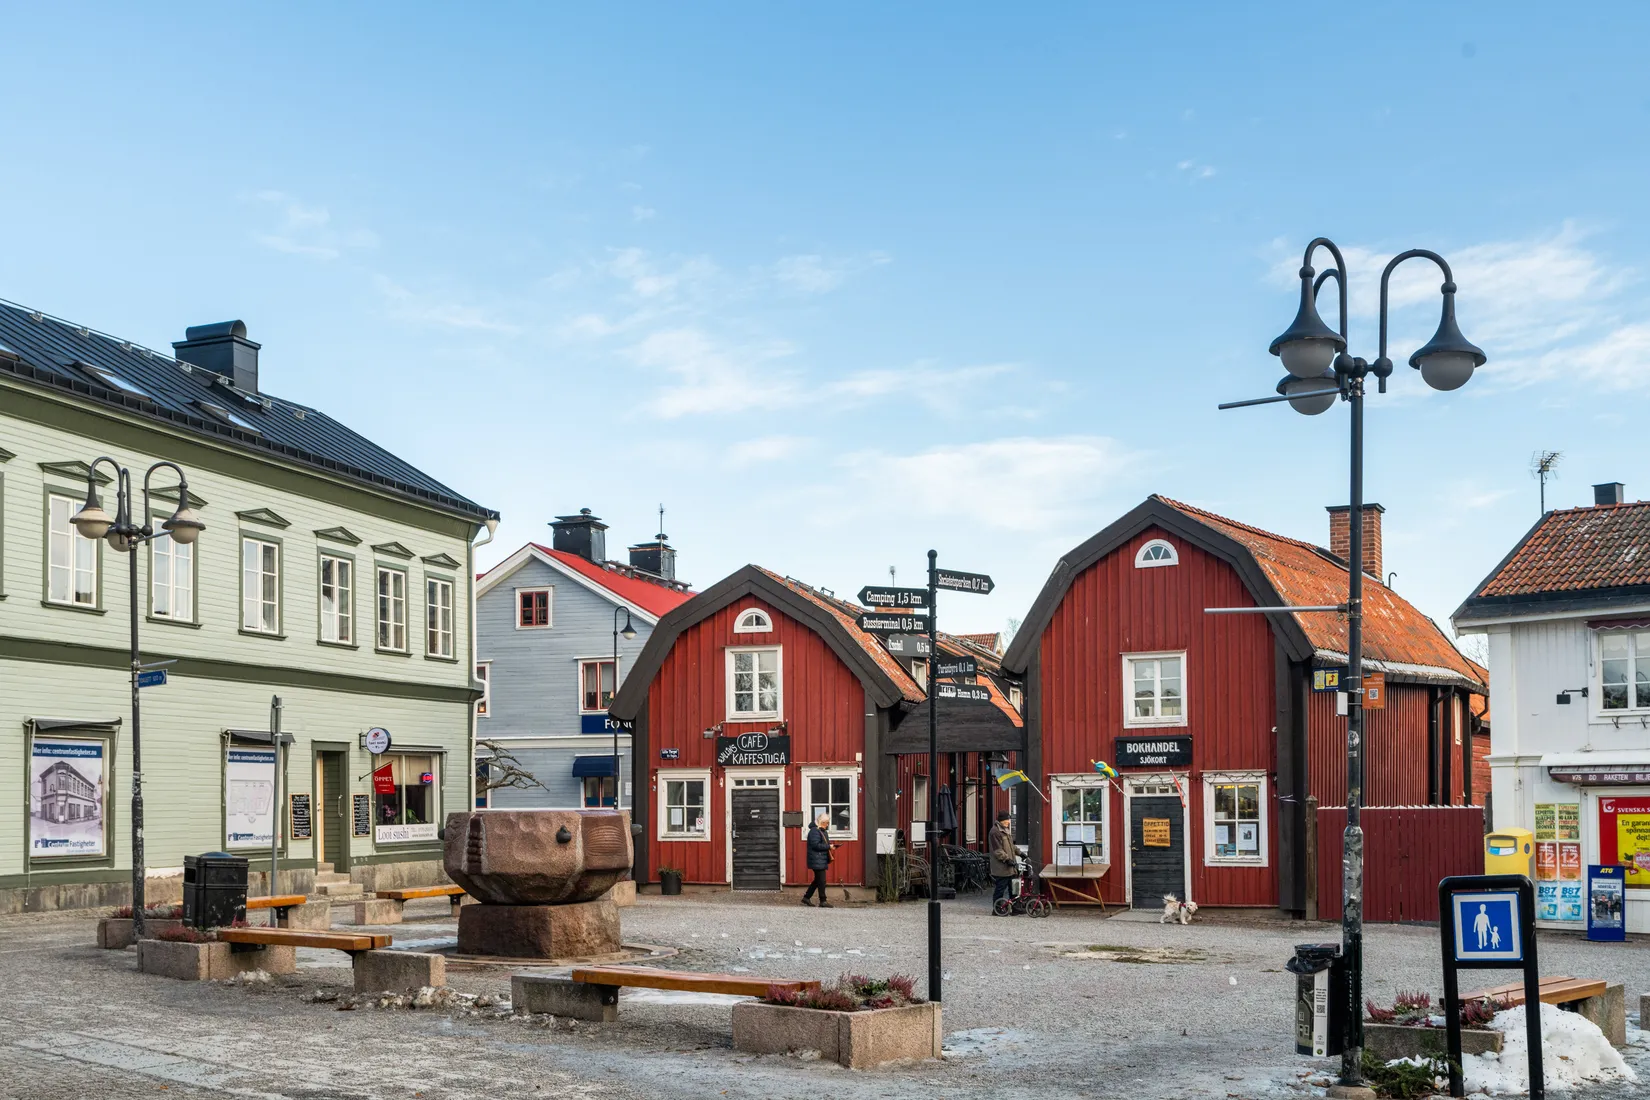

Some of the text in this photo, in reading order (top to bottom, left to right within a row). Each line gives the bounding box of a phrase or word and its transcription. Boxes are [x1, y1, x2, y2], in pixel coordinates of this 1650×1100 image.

[972, 577, 980, 591] 0,7
[981, 578, 989, 590] km
[866, 590, 922, 607] Camping 1,5 km
[862, 616, 924, 631] Bussterminal 0,5 km
[916, 641, 925, 653] 0,5
[966, 661, 974, 672] km
[971, 689, 981, 700] 0,3
[981, 690, 989, 700] km
[741, 733, 764, 748] CAFÉ
[1126, 742, 1180, 754] BOKHANDEL
[732, 752, 786, 765] KAFFESTUGA
[1139, 755, 1168, 764] SJÖKORT
[378, 827, 410, 840] Looi sushi
[69, 840, 96, 849] Fastigheter
